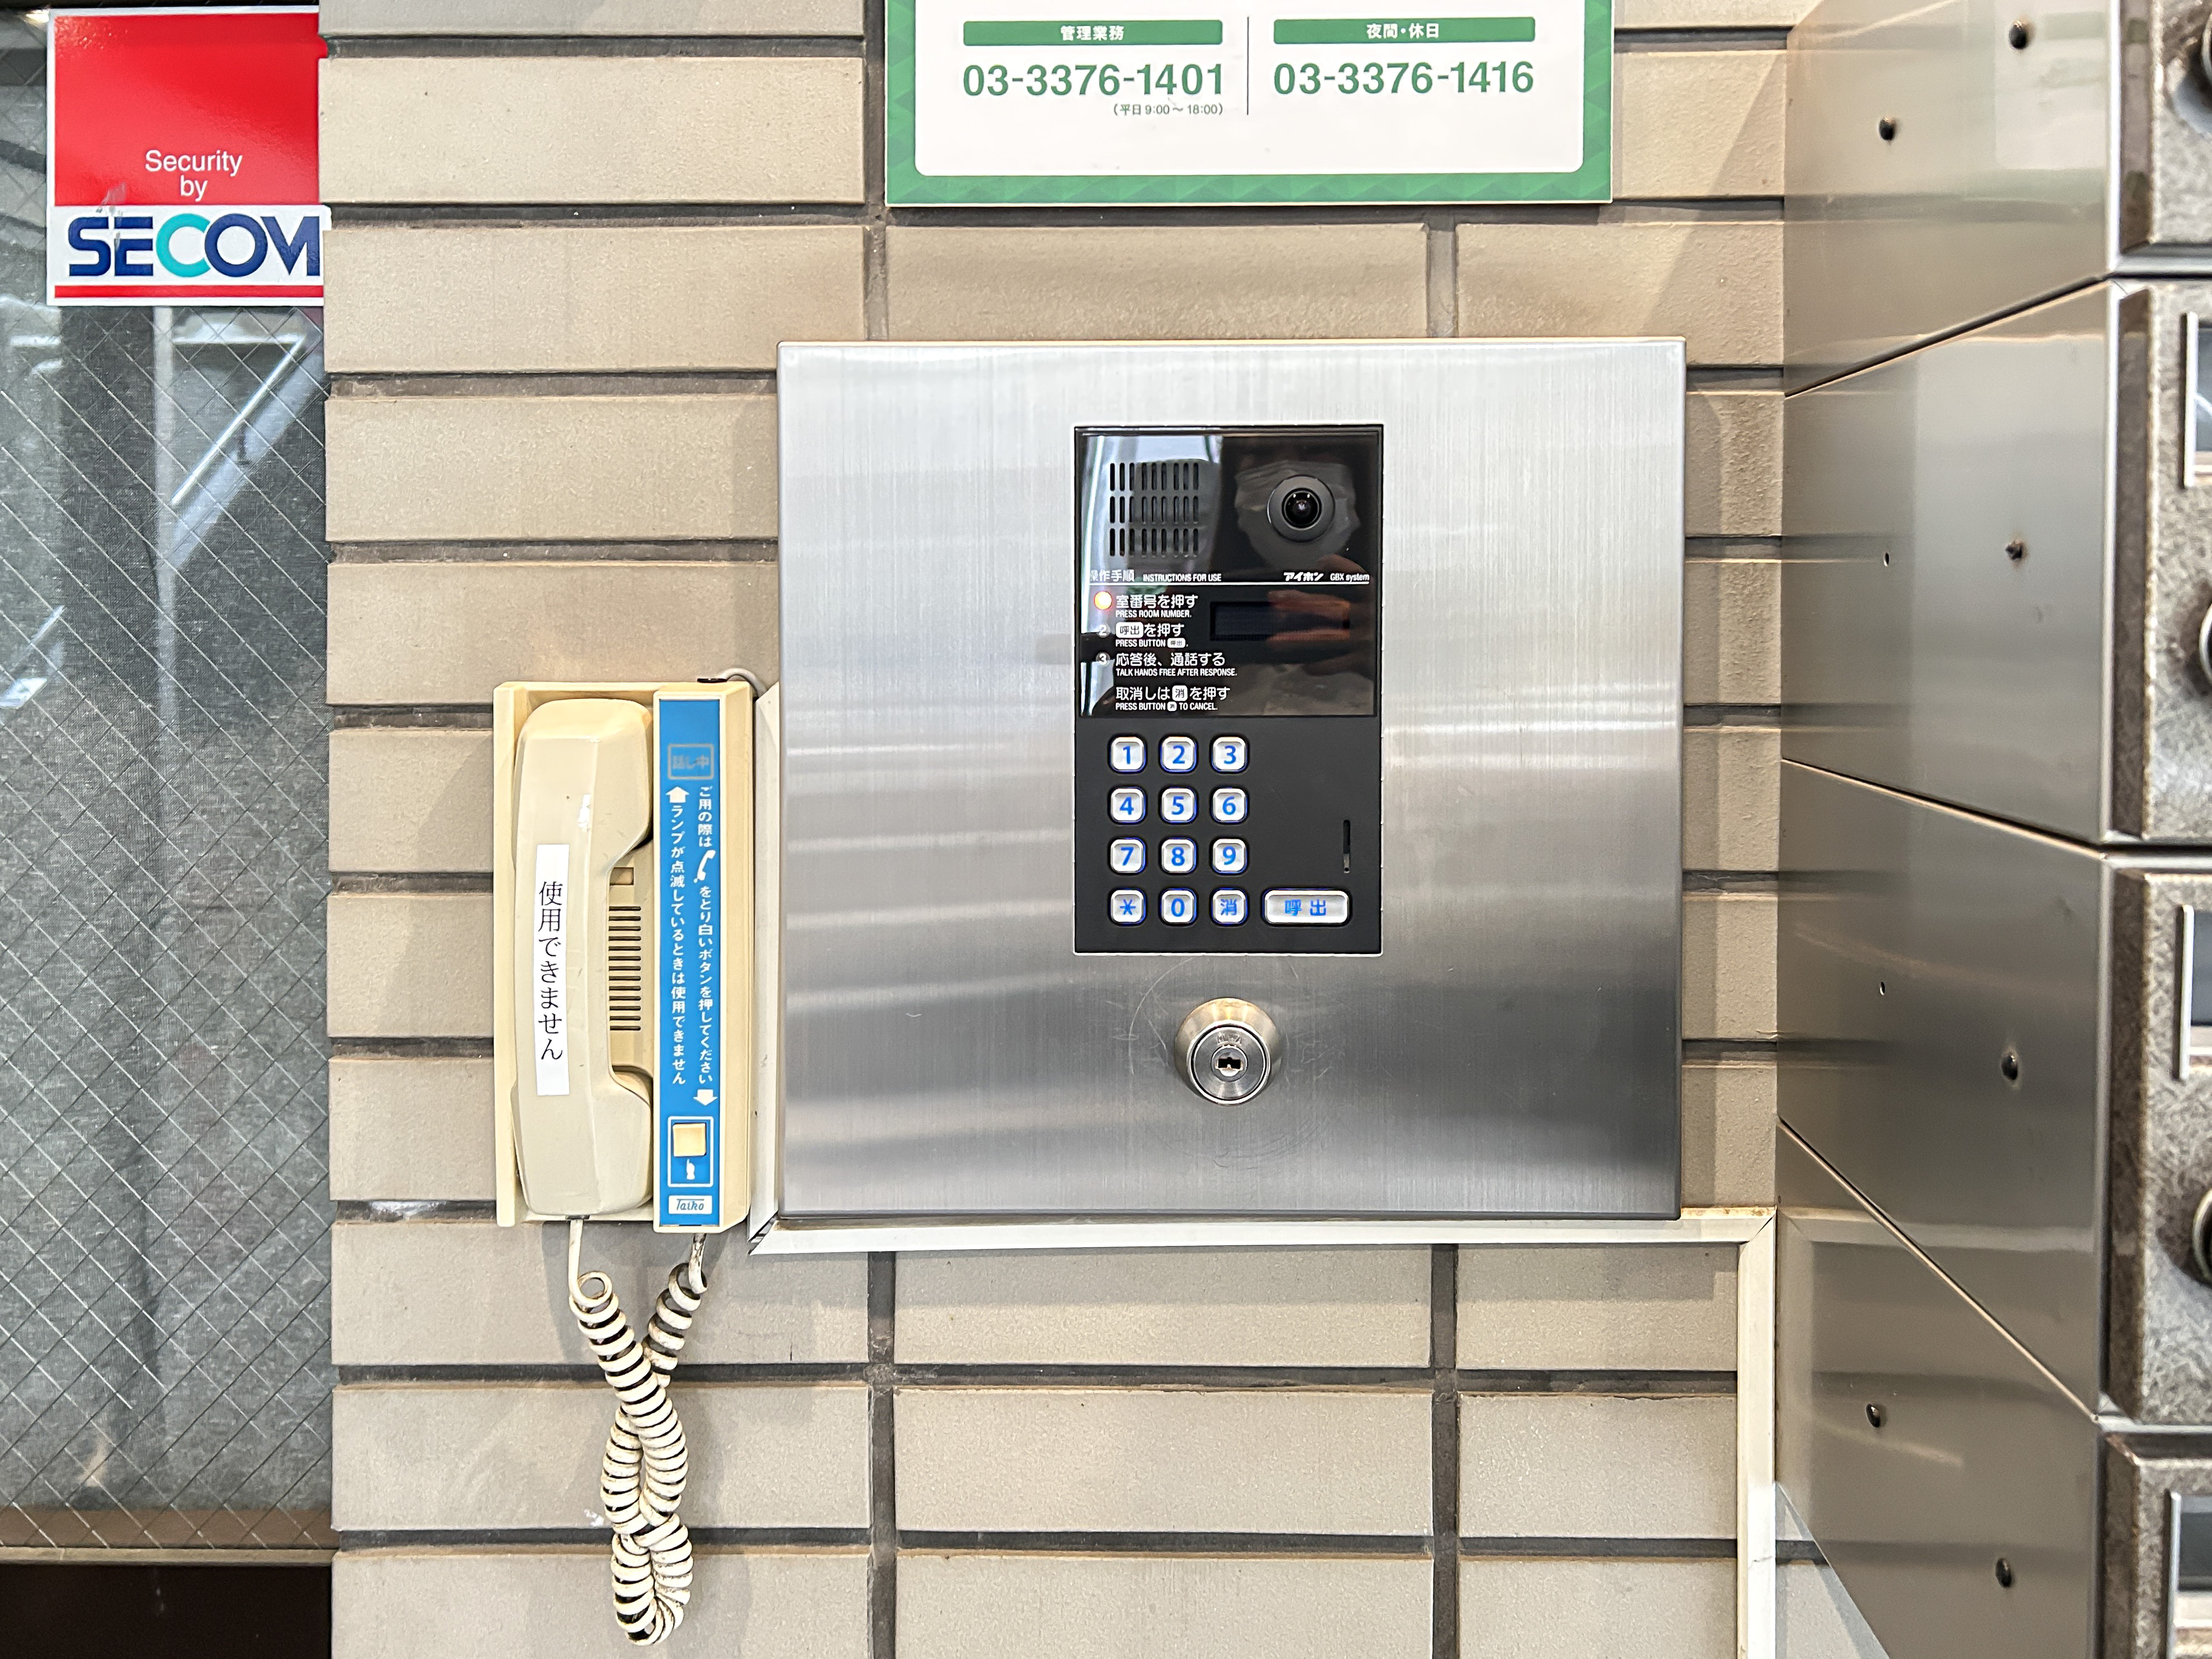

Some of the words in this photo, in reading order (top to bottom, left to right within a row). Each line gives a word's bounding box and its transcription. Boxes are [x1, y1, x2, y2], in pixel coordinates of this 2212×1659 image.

[1060, 25, 1125, 41] 管理業務
[1367, 23, 1440, 39] 夜間・休日
[963, 64, 1222, 96] 03-3376-1401
[1273, 61, 1534, 94] 03-3376-1416
[145, 149, 242, 176] Security
[179, 176, 208, 201] by
[68, 213, 320, 278] SECOM
[1143, 573, 1191, 582] INSTRUCTIONS
[1193, 573, 1207, 582] FOR
[1208, 573, 1222, 582] USE
[1283, 572, 1324, 582] アイホン
[1345, 573, 1370, 583] system
[1115, 594, 1198, 608] 室番号を押す
[1115, 610, 1137, 618] PRESS
[1138, 610, 1160, 618] ROOM
[1161, 610, 1192, 618] NUMBER.
[1099, 624, 1108, 636] 2
[1115, 639, 1137, 647] PRESS
[1139, 639, 1166, 647] BUTTON
[1099, 654, 1107, 665] 3
[1115, 652, 1226, 667] 応答後、通話する
[1116, 668, 1133, 676] TALK
[1134, 668, 1158, 676] HANDS
[1159, 668, 1176, 676] FREE
[1177, 668, 1199, 676] AFTER
[1200, 668, 1238, 676] RESPONSE.
[1115, 702, 1137, 710] PRESS
[1139, 702, 1166, 710] BUTTON
[1180, 702, 1188, 710] TO
[1189, 702, 1218, 710] CANCEL.
[1122, 745, 1131, 765] 1
[1172, 745, 1186, 765] 2
[1223, 745, 1237, 765] 3
[1119, 796, 1134, 816] 4
[1171, 796, 1185, 816] 5
[1222, 796, 1236, 816] 6
[1120, 847, 1134, 866] 7
[1171, 847, 1185, 867] 8
[1222, 846, 1236, 866] 9
[1170, 898, 1185, 917] 0
[1220, 899, 1237, 917] 消
[670, 805, 686, 1085] ランプが点滅しているときは使用できません
[538, 881, 563, 1060] 使用できません
